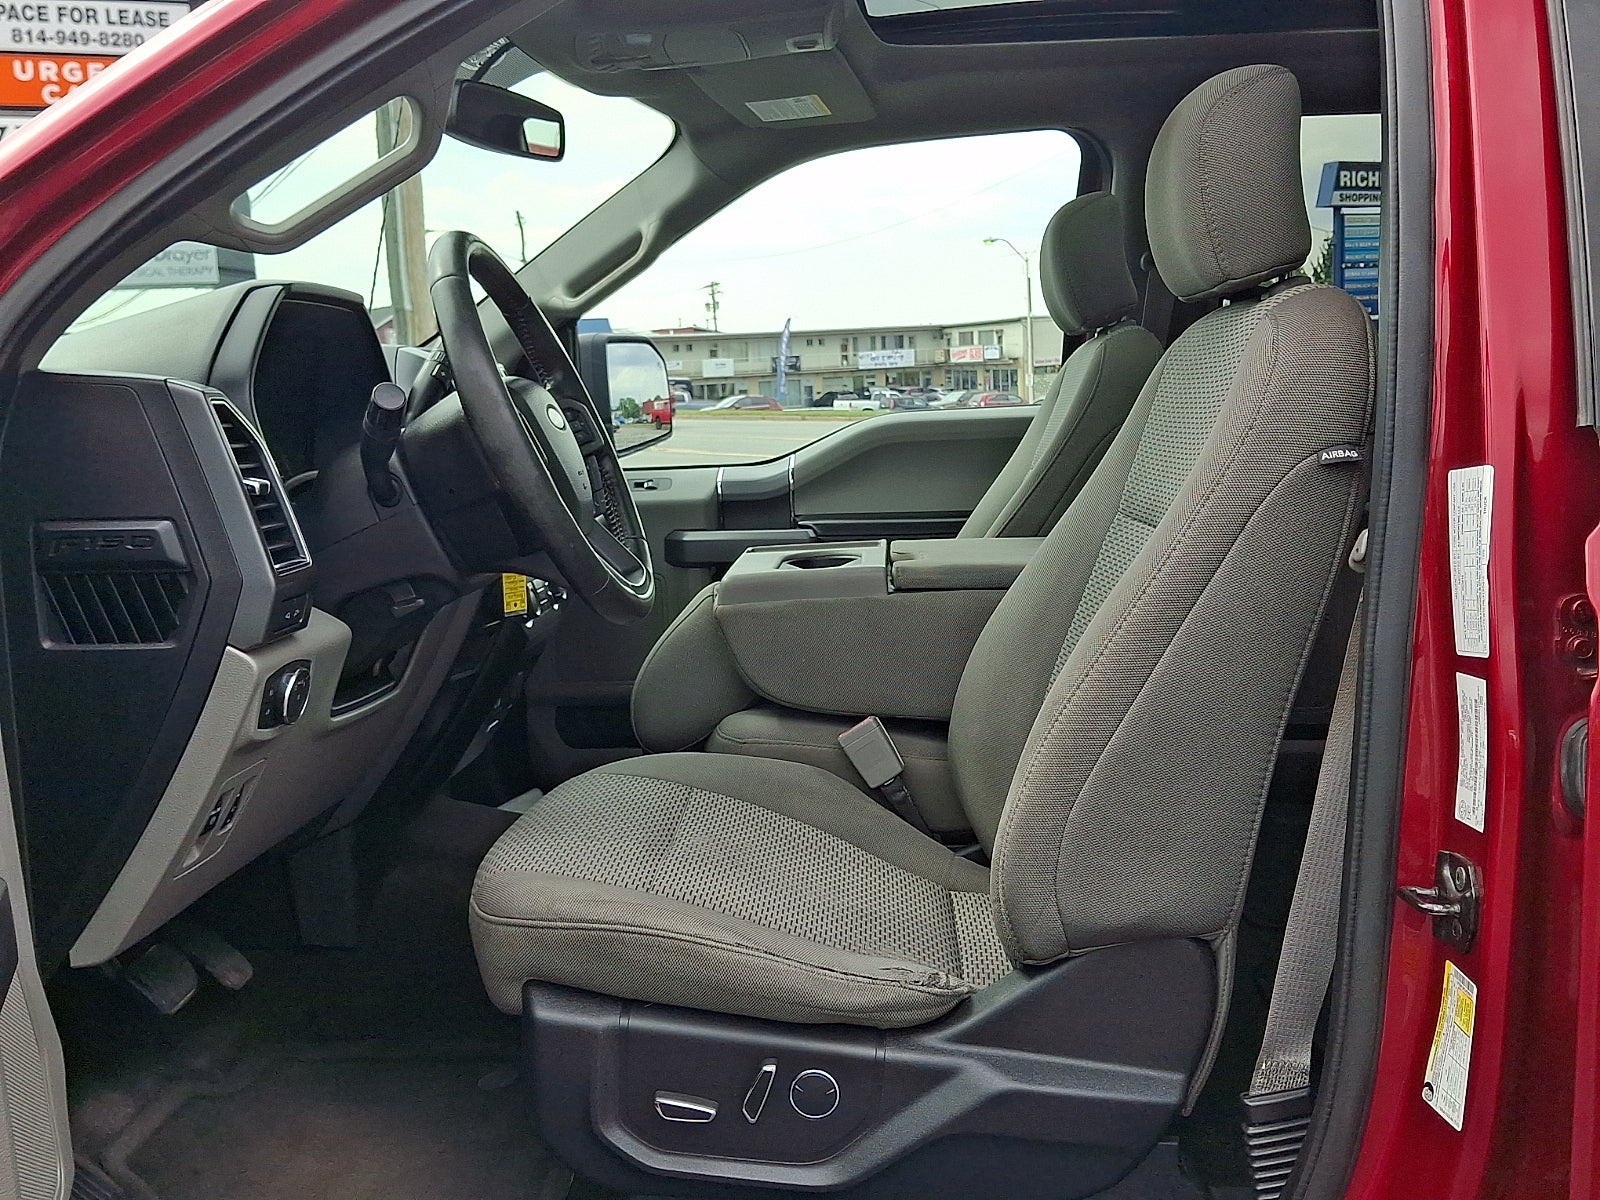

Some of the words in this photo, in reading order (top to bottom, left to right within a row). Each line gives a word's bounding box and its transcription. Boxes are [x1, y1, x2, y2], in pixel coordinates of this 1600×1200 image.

[57, 7, 98, 24] FOR
[106, 9, 169, 28] LEASE
[12, 28, 144, 47] 814-949-8280
[1321, 449, 1359, 461] AIRBAG
